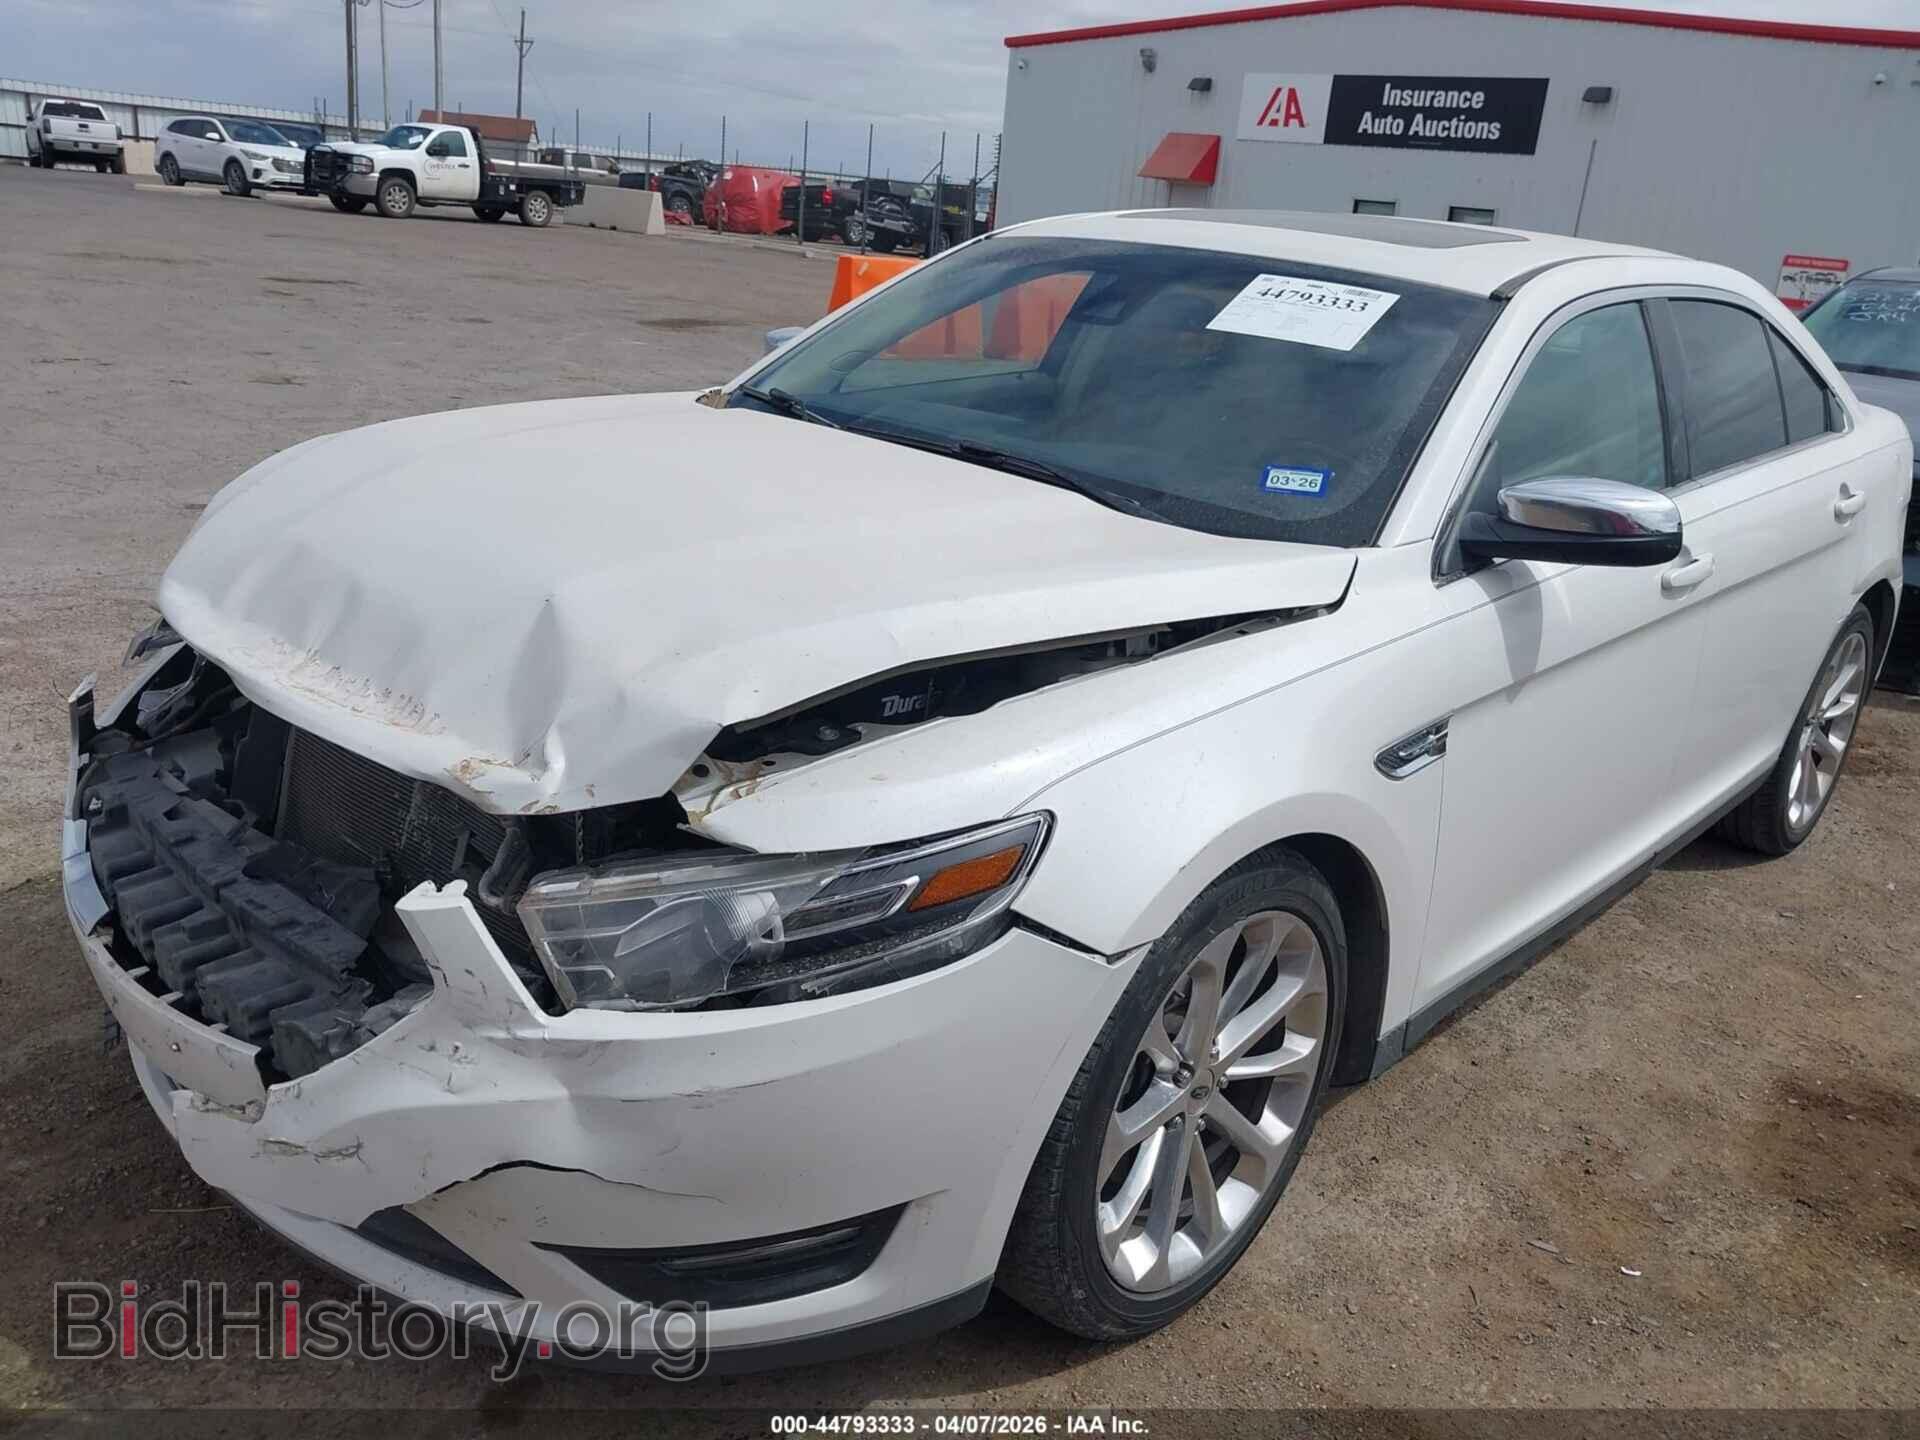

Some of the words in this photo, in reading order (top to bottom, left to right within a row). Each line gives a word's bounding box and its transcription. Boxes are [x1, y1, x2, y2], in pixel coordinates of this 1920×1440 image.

[1382, 83, 1485, 109] Insurance
[1357, 111, 1405, 136] Auto
[1408, 113, 1501, 140] Auctions
[1256, 287, 1369, 313] 44793333
[1298, 479, 1318, 488] 26
